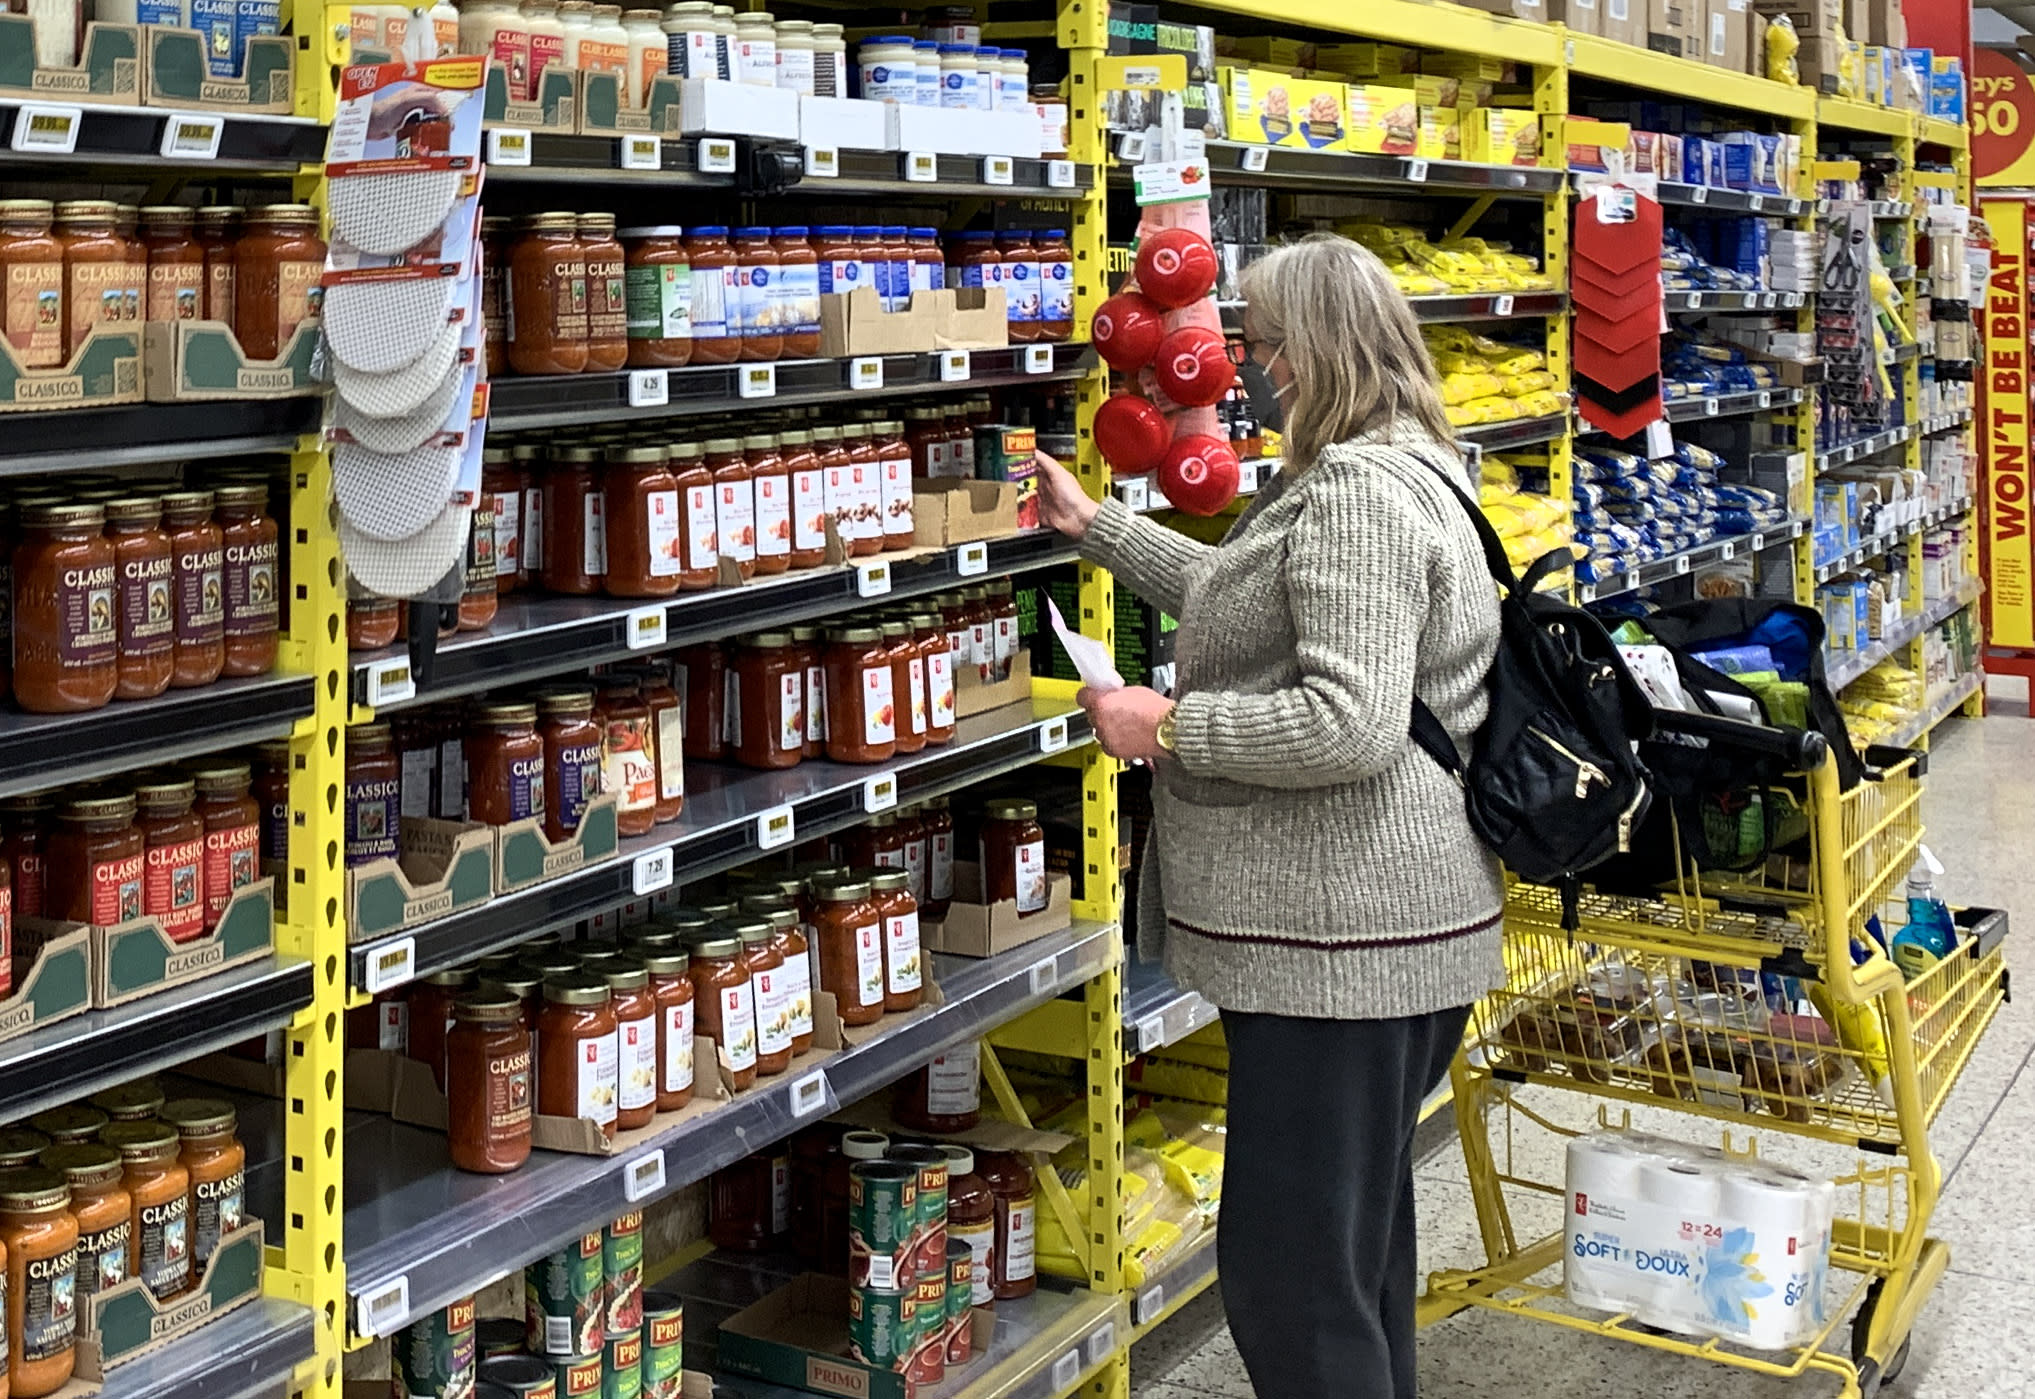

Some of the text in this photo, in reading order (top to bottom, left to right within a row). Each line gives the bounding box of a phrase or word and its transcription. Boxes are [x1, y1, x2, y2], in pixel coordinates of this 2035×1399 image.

[1990, 250, 2021, 339] BEAT
[1992, 351, 2022, 394] BE
[1994, 408, 2026, 541] WON'T
[648, 858, 664, 875] 7.29
[1681, 1220, 1694, 1233] 12
[1702, 1223, 1723, 1239] 24
[1573, 1232, 1621, 1262] SOFT
[1635, 1249, 1690, 1278] DOUX
[814, 1366, 862, 1391] PRIMO
